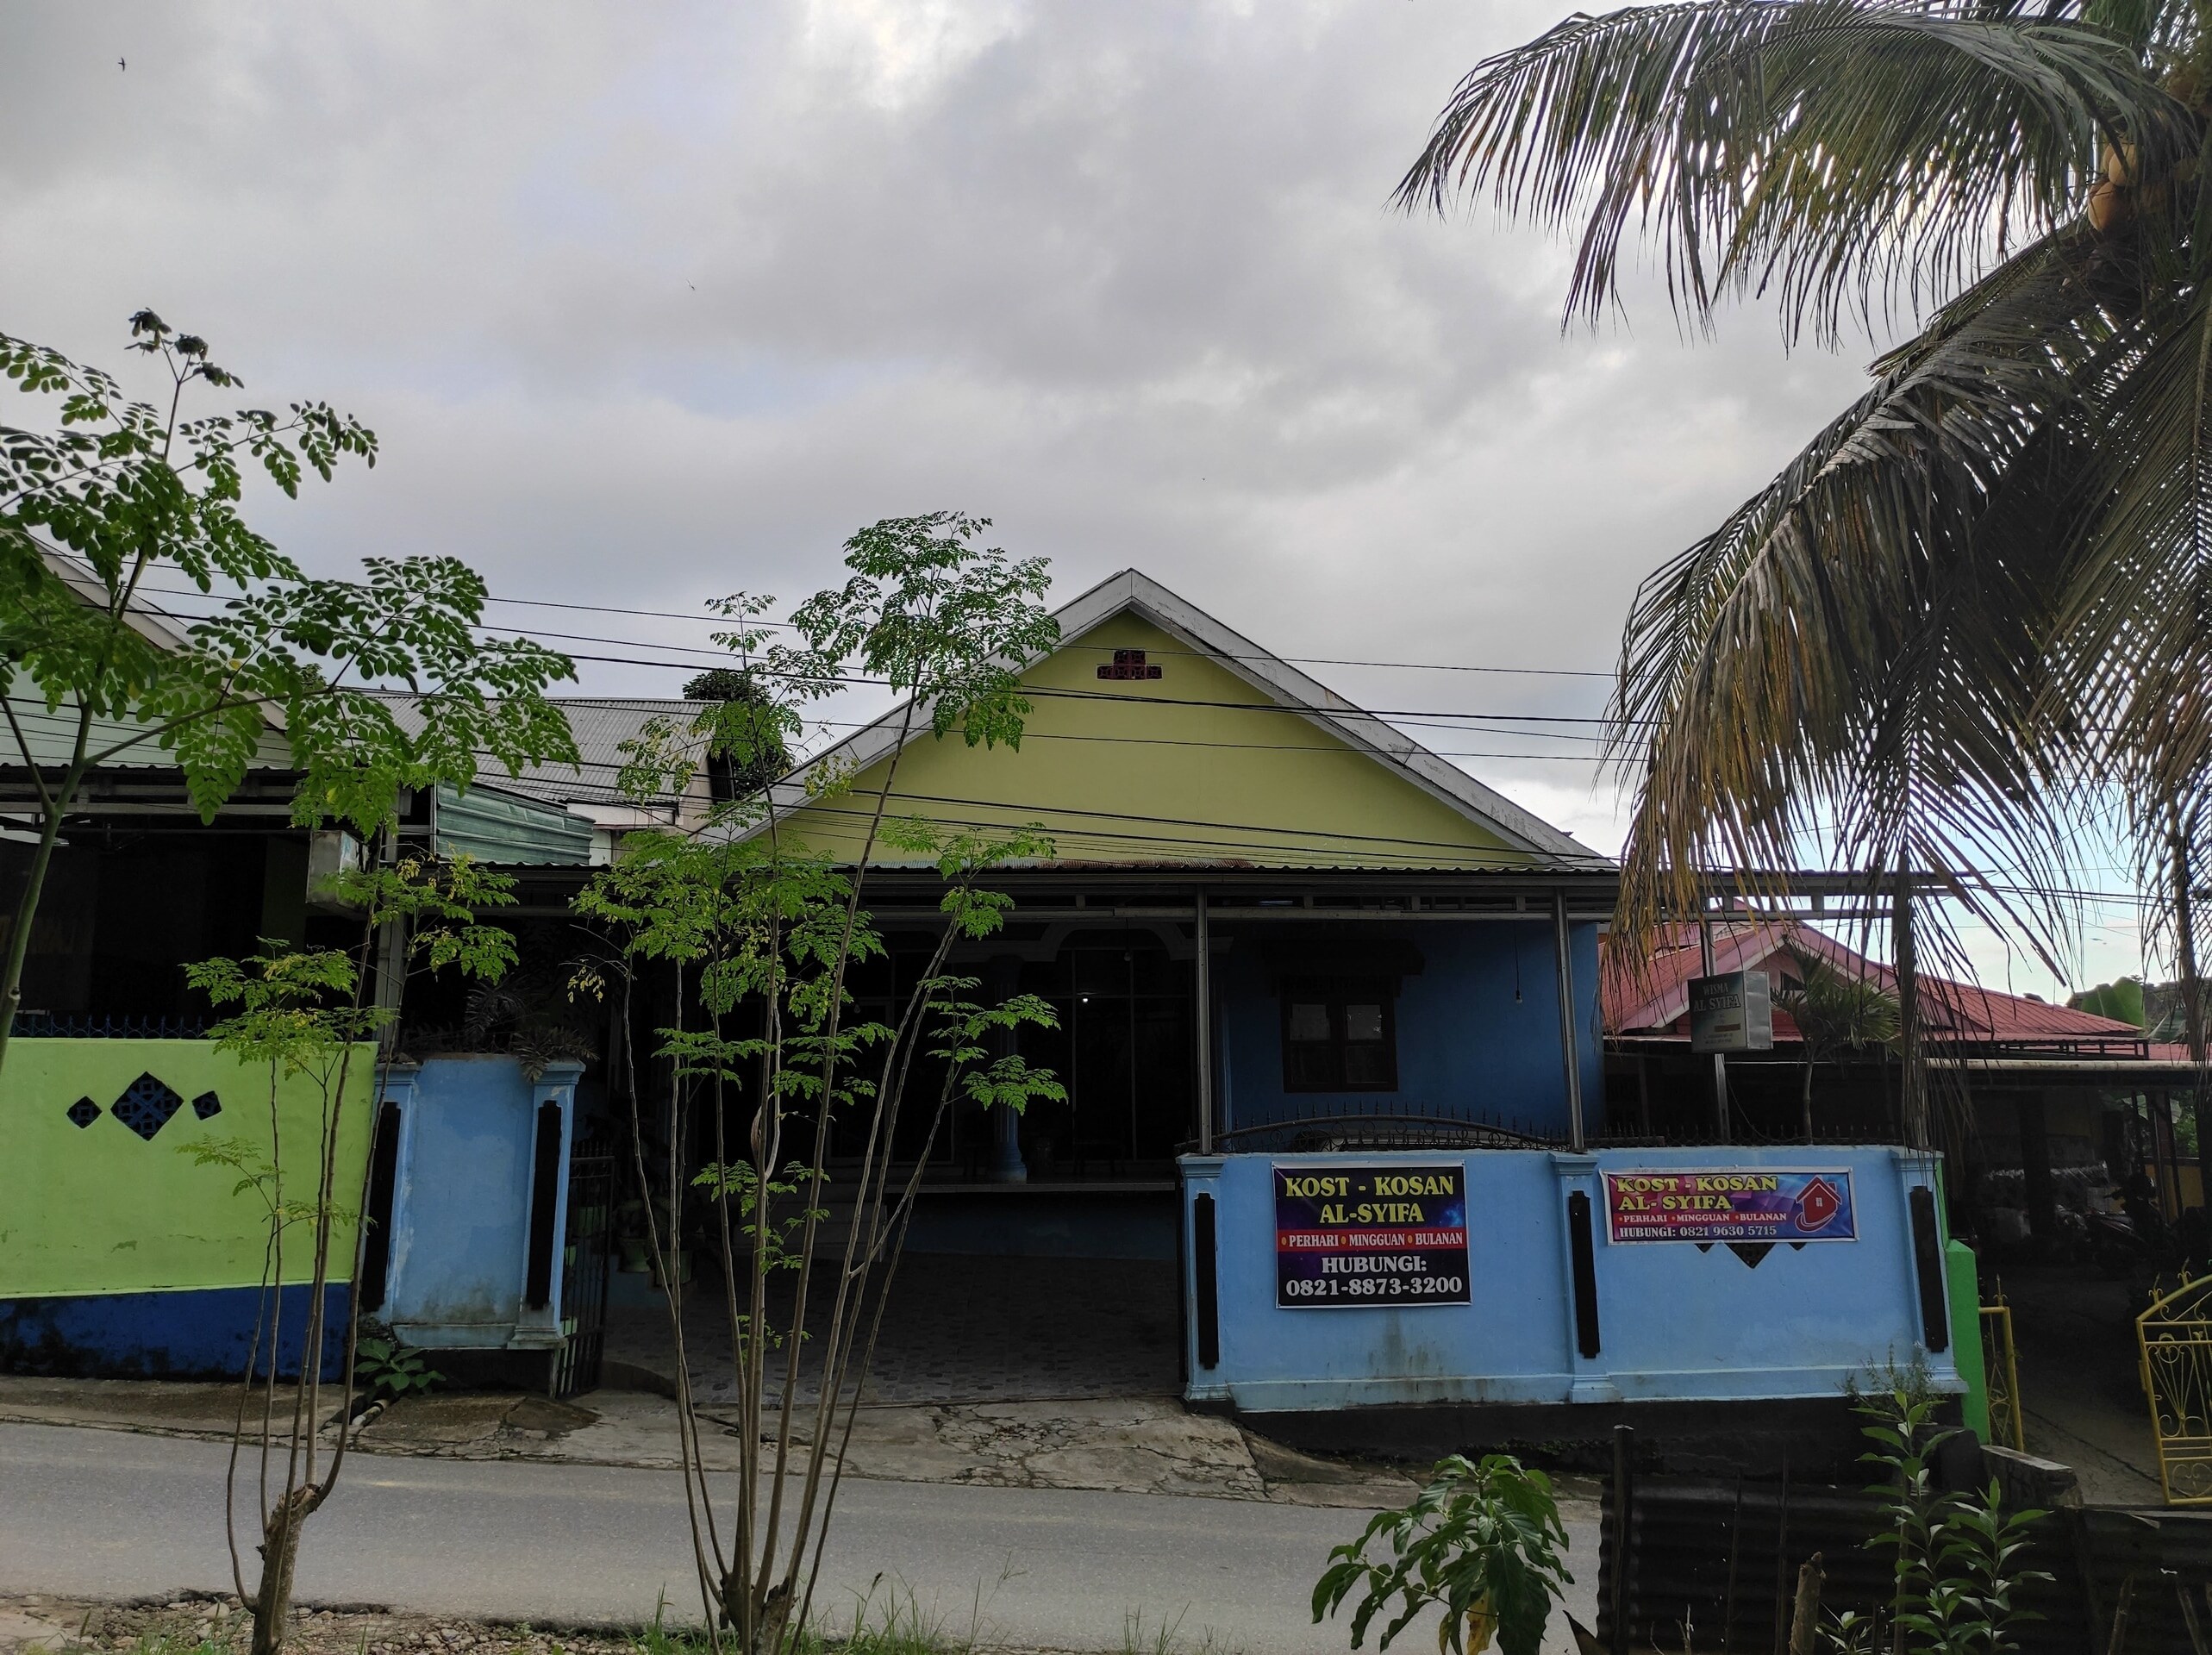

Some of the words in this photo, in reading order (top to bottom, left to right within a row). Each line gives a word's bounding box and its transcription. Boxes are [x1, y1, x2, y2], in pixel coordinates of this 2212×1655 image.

[1709, 995, 1741, 1010] SYIFA
[1285, 1177, 1349, 1197] KOST
[1374, 1176, 1453, 1196] KOSAN
[1616, 1177, 1679, 1192] KOST
[1696, 1176, 1778, 1191] KOSAN
[1662, 1195, 1733, 1210] SYIFA
[1319, 1202, 1424, 1223] AL-SYIFA
[1623, 1215, 1667, 1223] PERHARI
[1676, 1214, 1730, 1222] MINGGUAN
[1740, 1213, 1787, 1221] BULANAN
[1289, 1234, 1339, 1247] PERHARI
[1349, 1233, 1405, 1246] MINGGUAN
[1415, 1232, 1463, 1245] BULANAN
[1619, 1227, 1676, 1238] HUBUNGI:
[1679, 1227, 1709, 1237] 0821
[1714, 1226, 1744, 1236] 9630
[1747, 1226, 1778, 1236] 5715
[1322, 1256, 1428, 1273] HUBUNGI:
[1285, 1277, 1463, 1296] 0821-8873-3200
